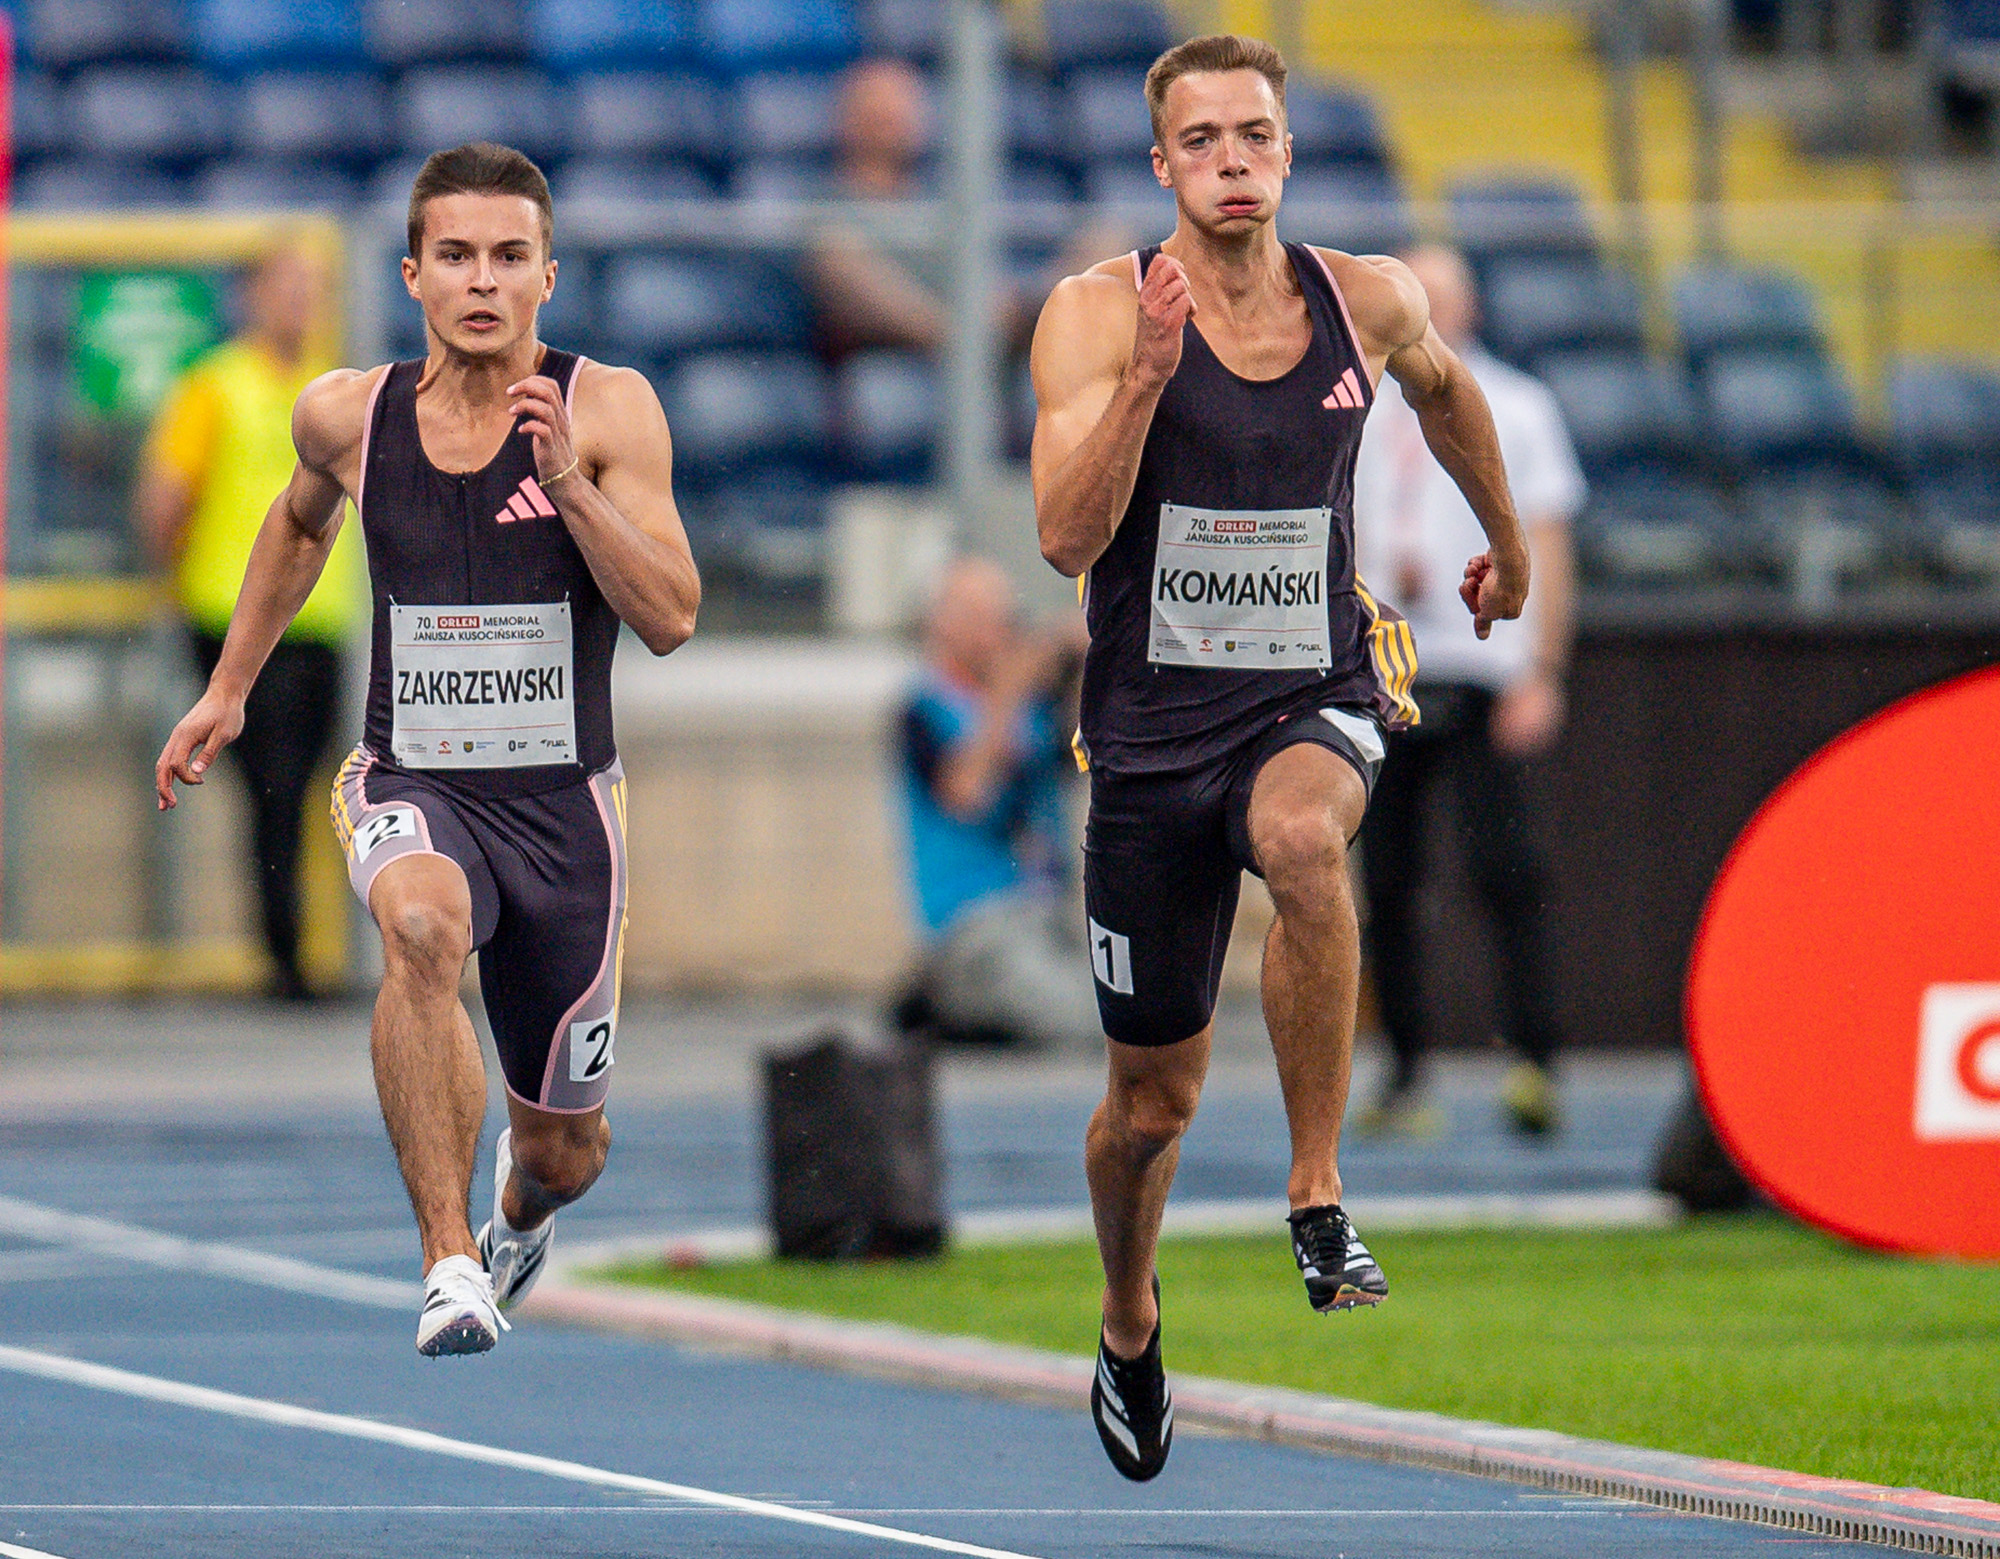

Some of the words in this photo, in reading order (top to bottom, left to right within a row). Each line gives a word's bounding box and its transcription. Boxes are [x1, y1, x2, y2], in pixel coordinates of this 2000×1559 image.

[1184, 532, 1231, 544] JANUSZA
[1234, 532, 1309, 545] KUSOCIŃSKIEGO
[1191, 517, 1211, 532] 70.
[1217, 522, 1255, 531] ORLEN
[1158, 565, 1320, 607] KOMAŃSKI
[413, 631, 455, 641] JANUSZA
[458, 628, 544, 641] KUSOCIŃSKIEGO
[416, 616, 435, 629] 70.
[439, 617, 478, 628] ORLEN
[398, 666, 563, 705] ZAKRZEWSKI
[368, 815, 400, 850] 2
[1098, 934, 1115, 986] 1
[584, 1021, 610, 1077] 2
